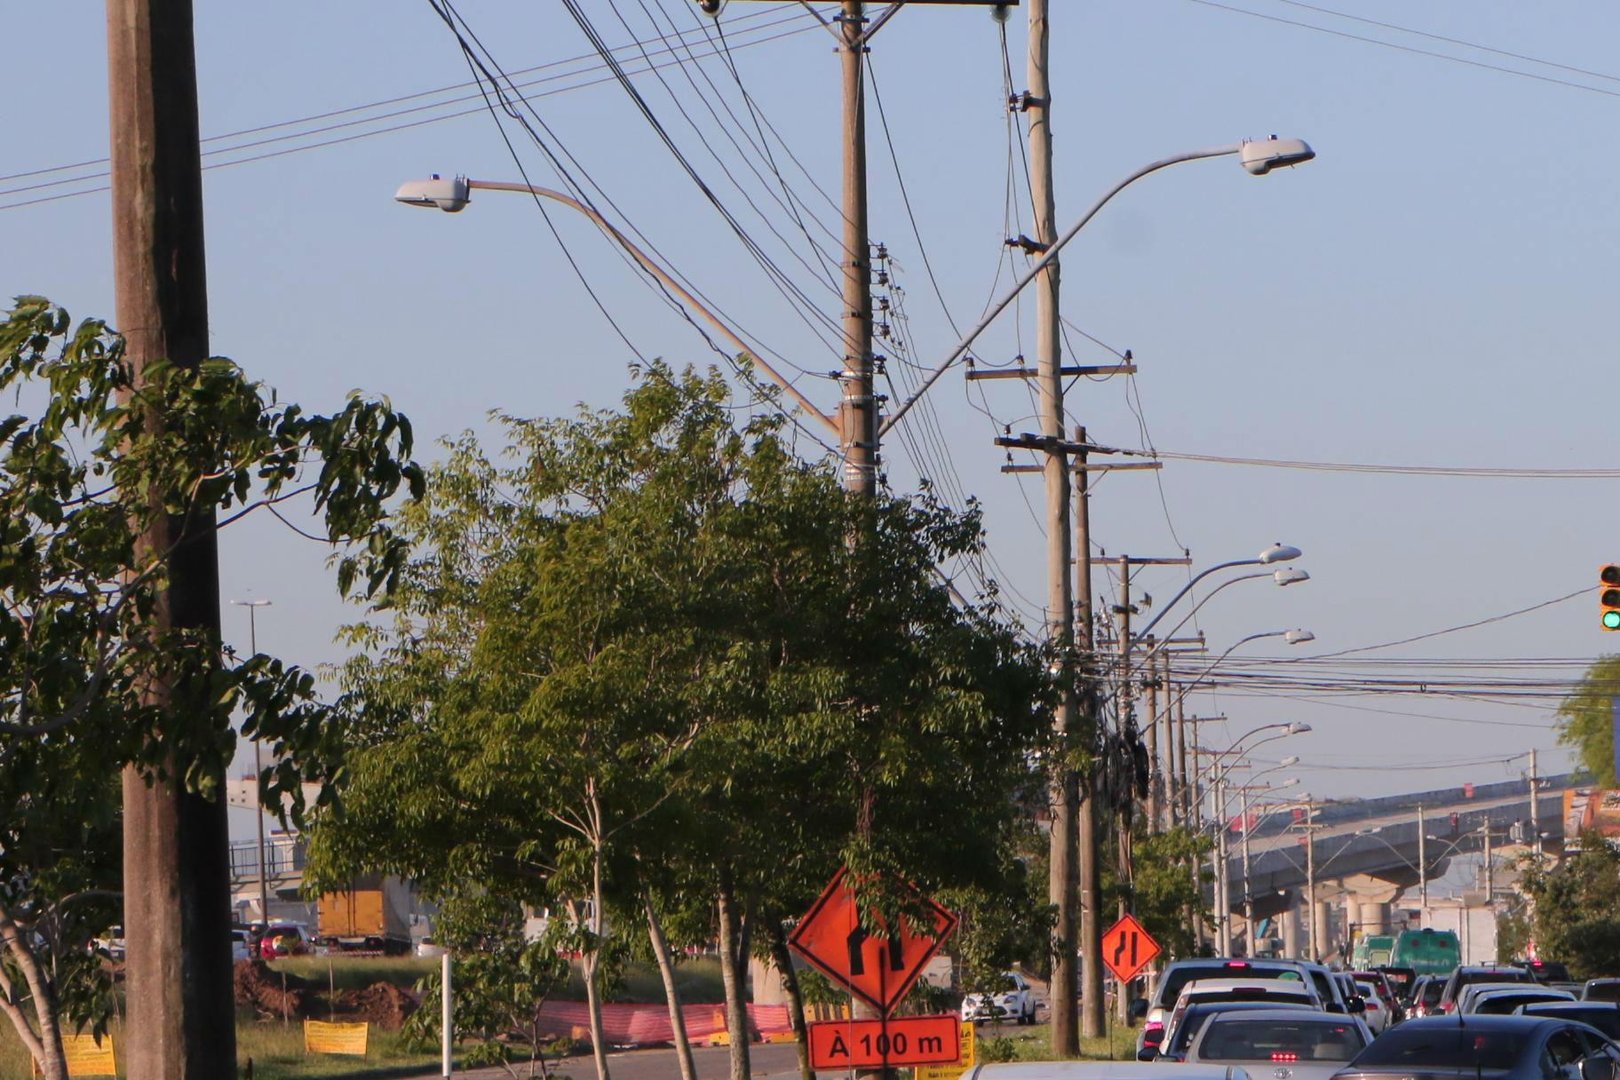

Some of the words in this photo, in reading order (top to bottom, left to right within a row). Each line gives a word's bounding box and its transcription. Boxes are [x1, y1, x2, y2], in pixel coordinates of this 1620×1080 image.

[829, 1030, 850, 1058] À
[860, 1032, 908, 1057] 100
[918, 1035, 942, 1054] m
